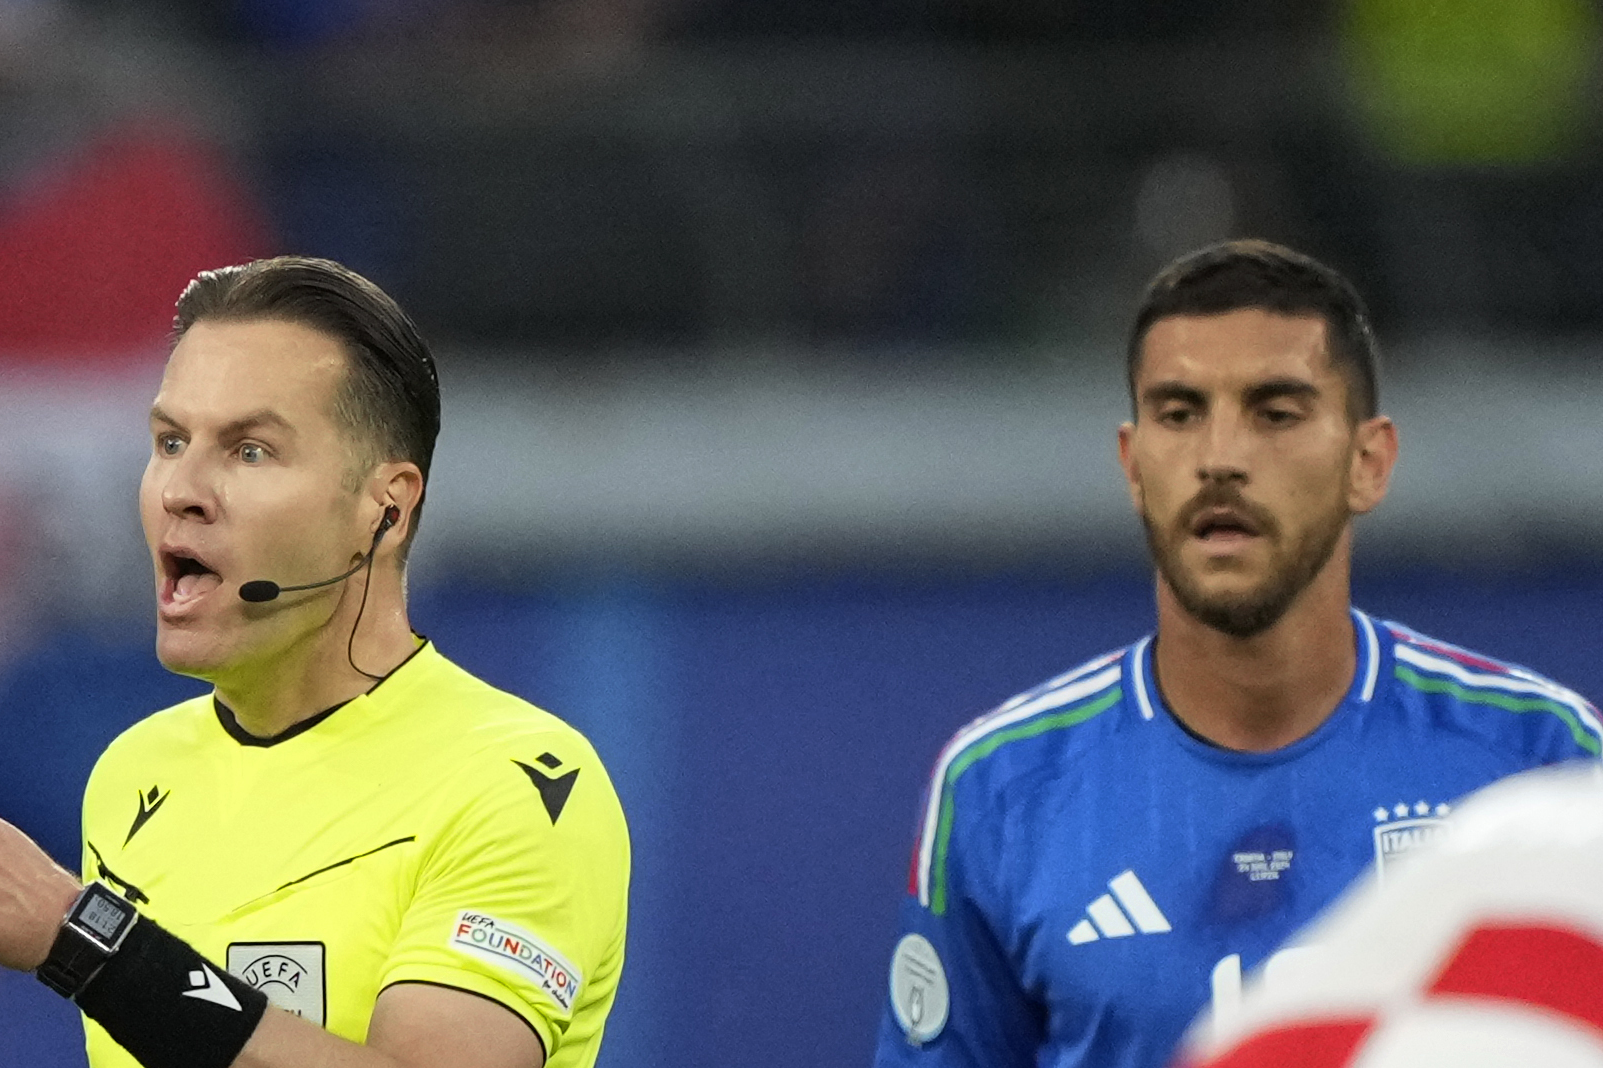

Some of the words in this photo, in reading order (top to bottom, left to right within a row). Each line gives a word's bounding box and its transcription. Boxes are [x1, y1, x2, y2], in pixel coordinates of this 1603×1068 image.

[1382, 826, 1436, 852] ITALI
[462, 912, 495, 929] UEFA
[245, 960, 301, 989] UEFA
[457, 923, 578, 999] FOUNDATION
